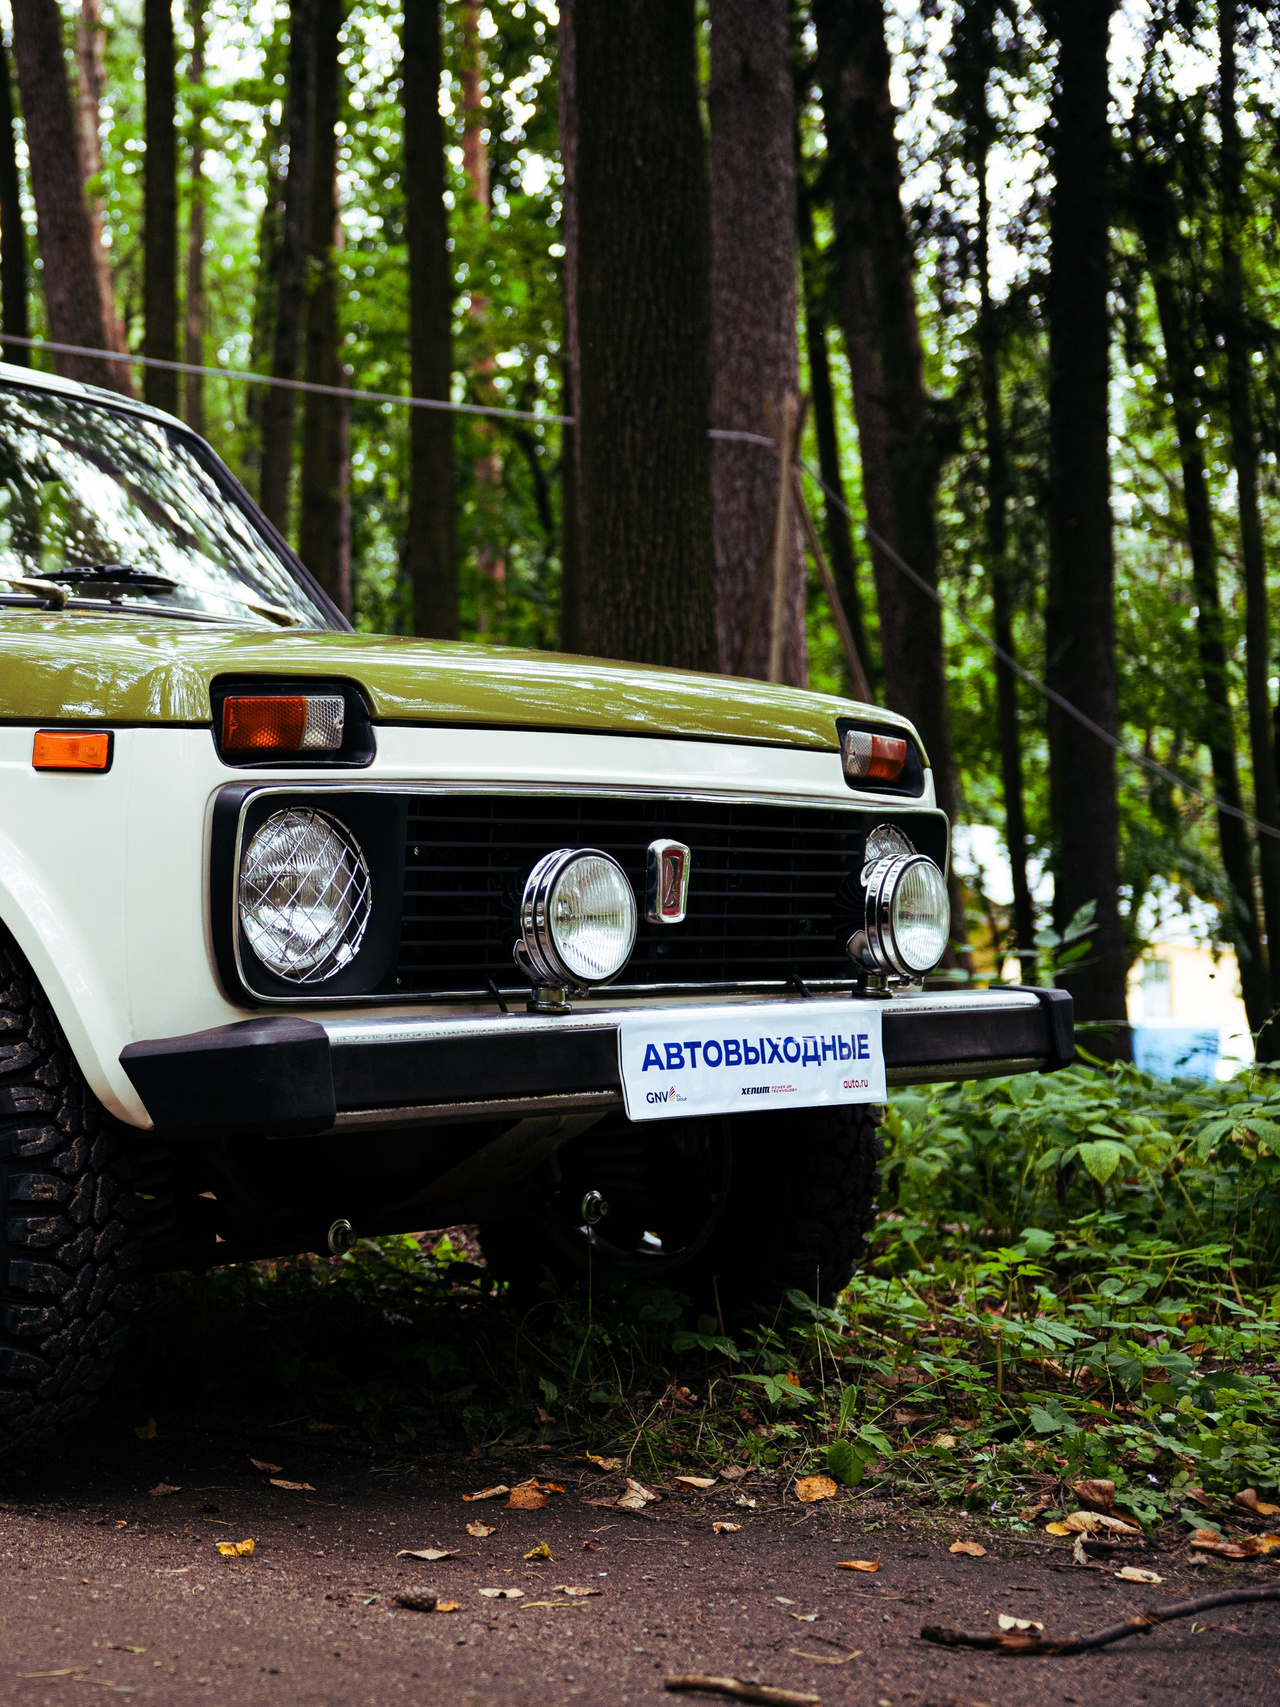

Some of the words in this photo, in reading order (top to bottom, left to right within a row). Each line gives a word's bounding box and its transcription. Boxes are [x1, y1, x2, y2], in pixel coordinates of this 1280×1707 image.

[641, 1034, 870, 1071] АВТОВЫХОДНЫЕ
[843, 1078, 869, 1089] auto.ru
[646, 1091, 668, 1103] GNV
